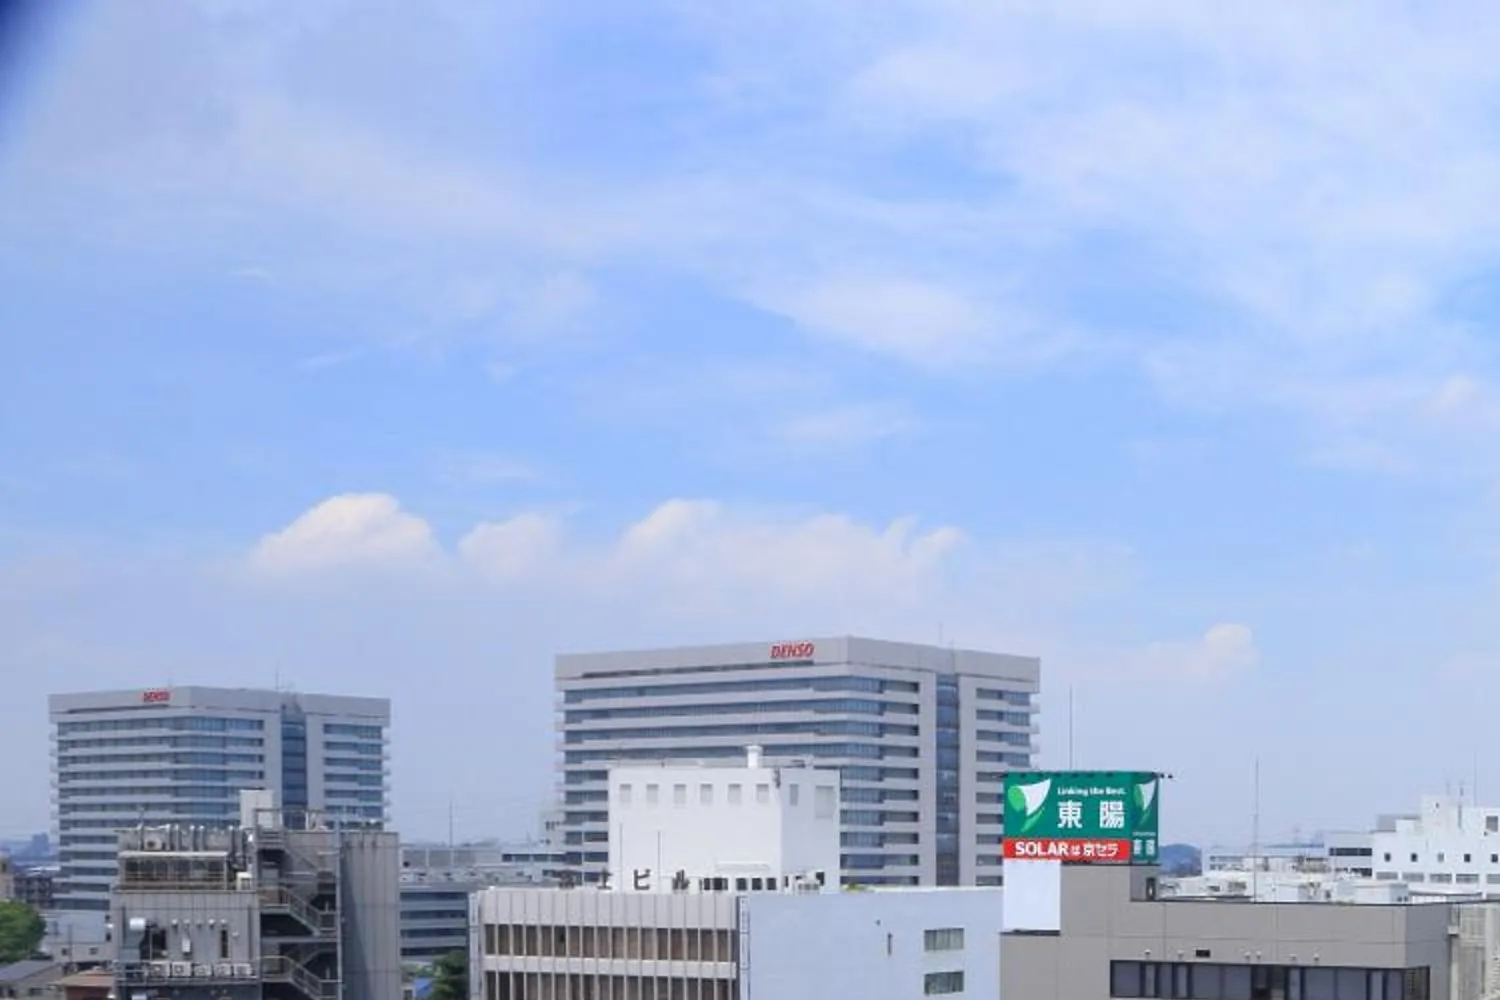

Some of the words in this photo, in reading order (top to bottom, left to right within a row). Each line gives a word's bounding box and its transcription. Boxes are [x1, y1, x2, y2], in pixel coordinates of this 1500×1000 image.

[771, 643, 815, 658] DENSO
[1057, 786, 1088, 797] Linking
[1057, 799, 1125, 829] 東陽
